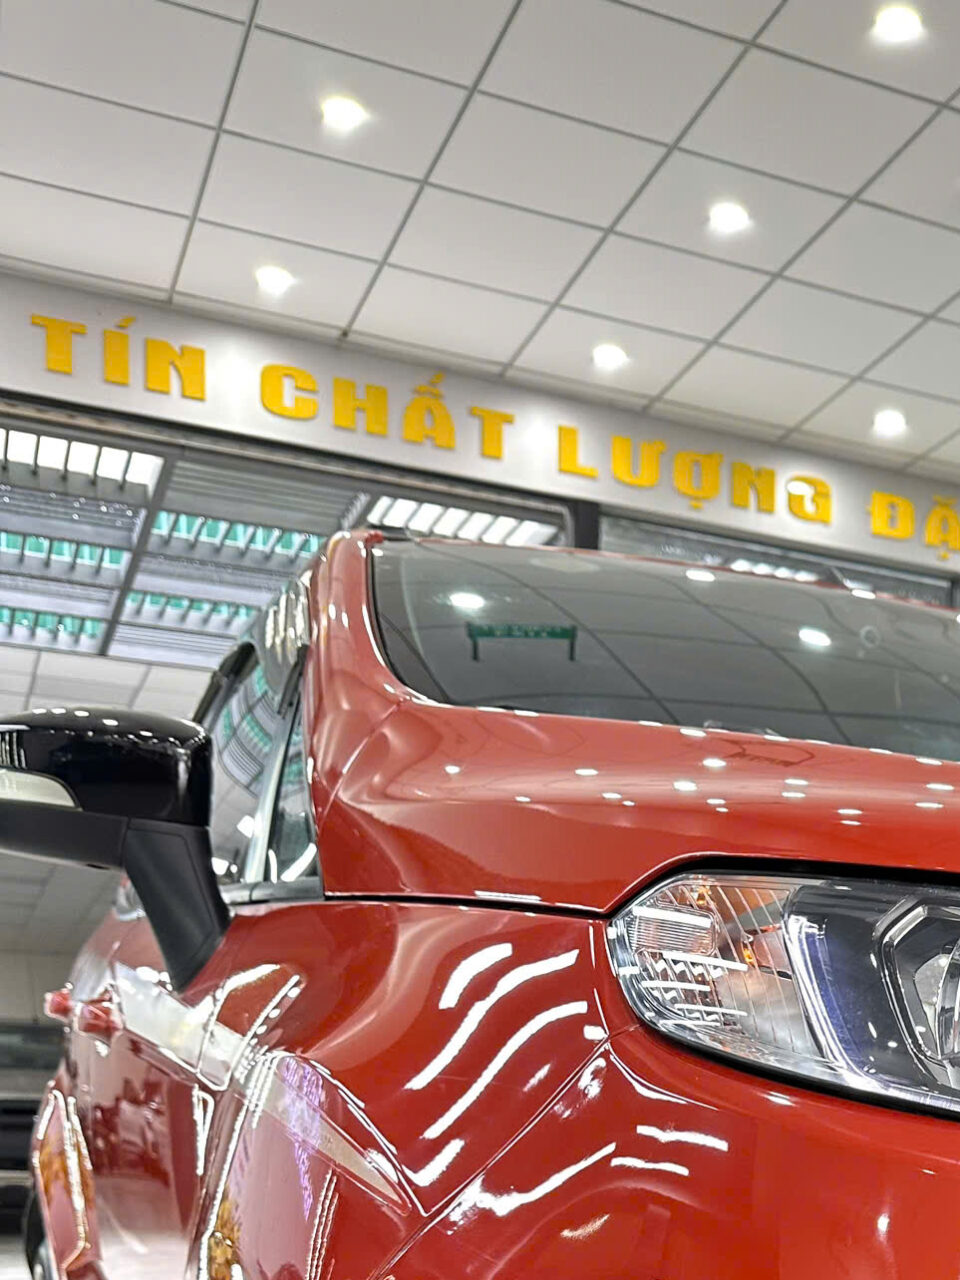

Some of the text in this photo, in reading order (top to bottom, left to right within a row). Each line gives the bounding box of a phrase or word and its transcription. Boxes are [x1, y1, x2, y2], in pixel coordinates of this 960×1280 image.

[31, 313, 207, 402] TÍN
[259, 363, 516, 460] CHẤT
[557, 425, 833, 525] LƯỢNG
